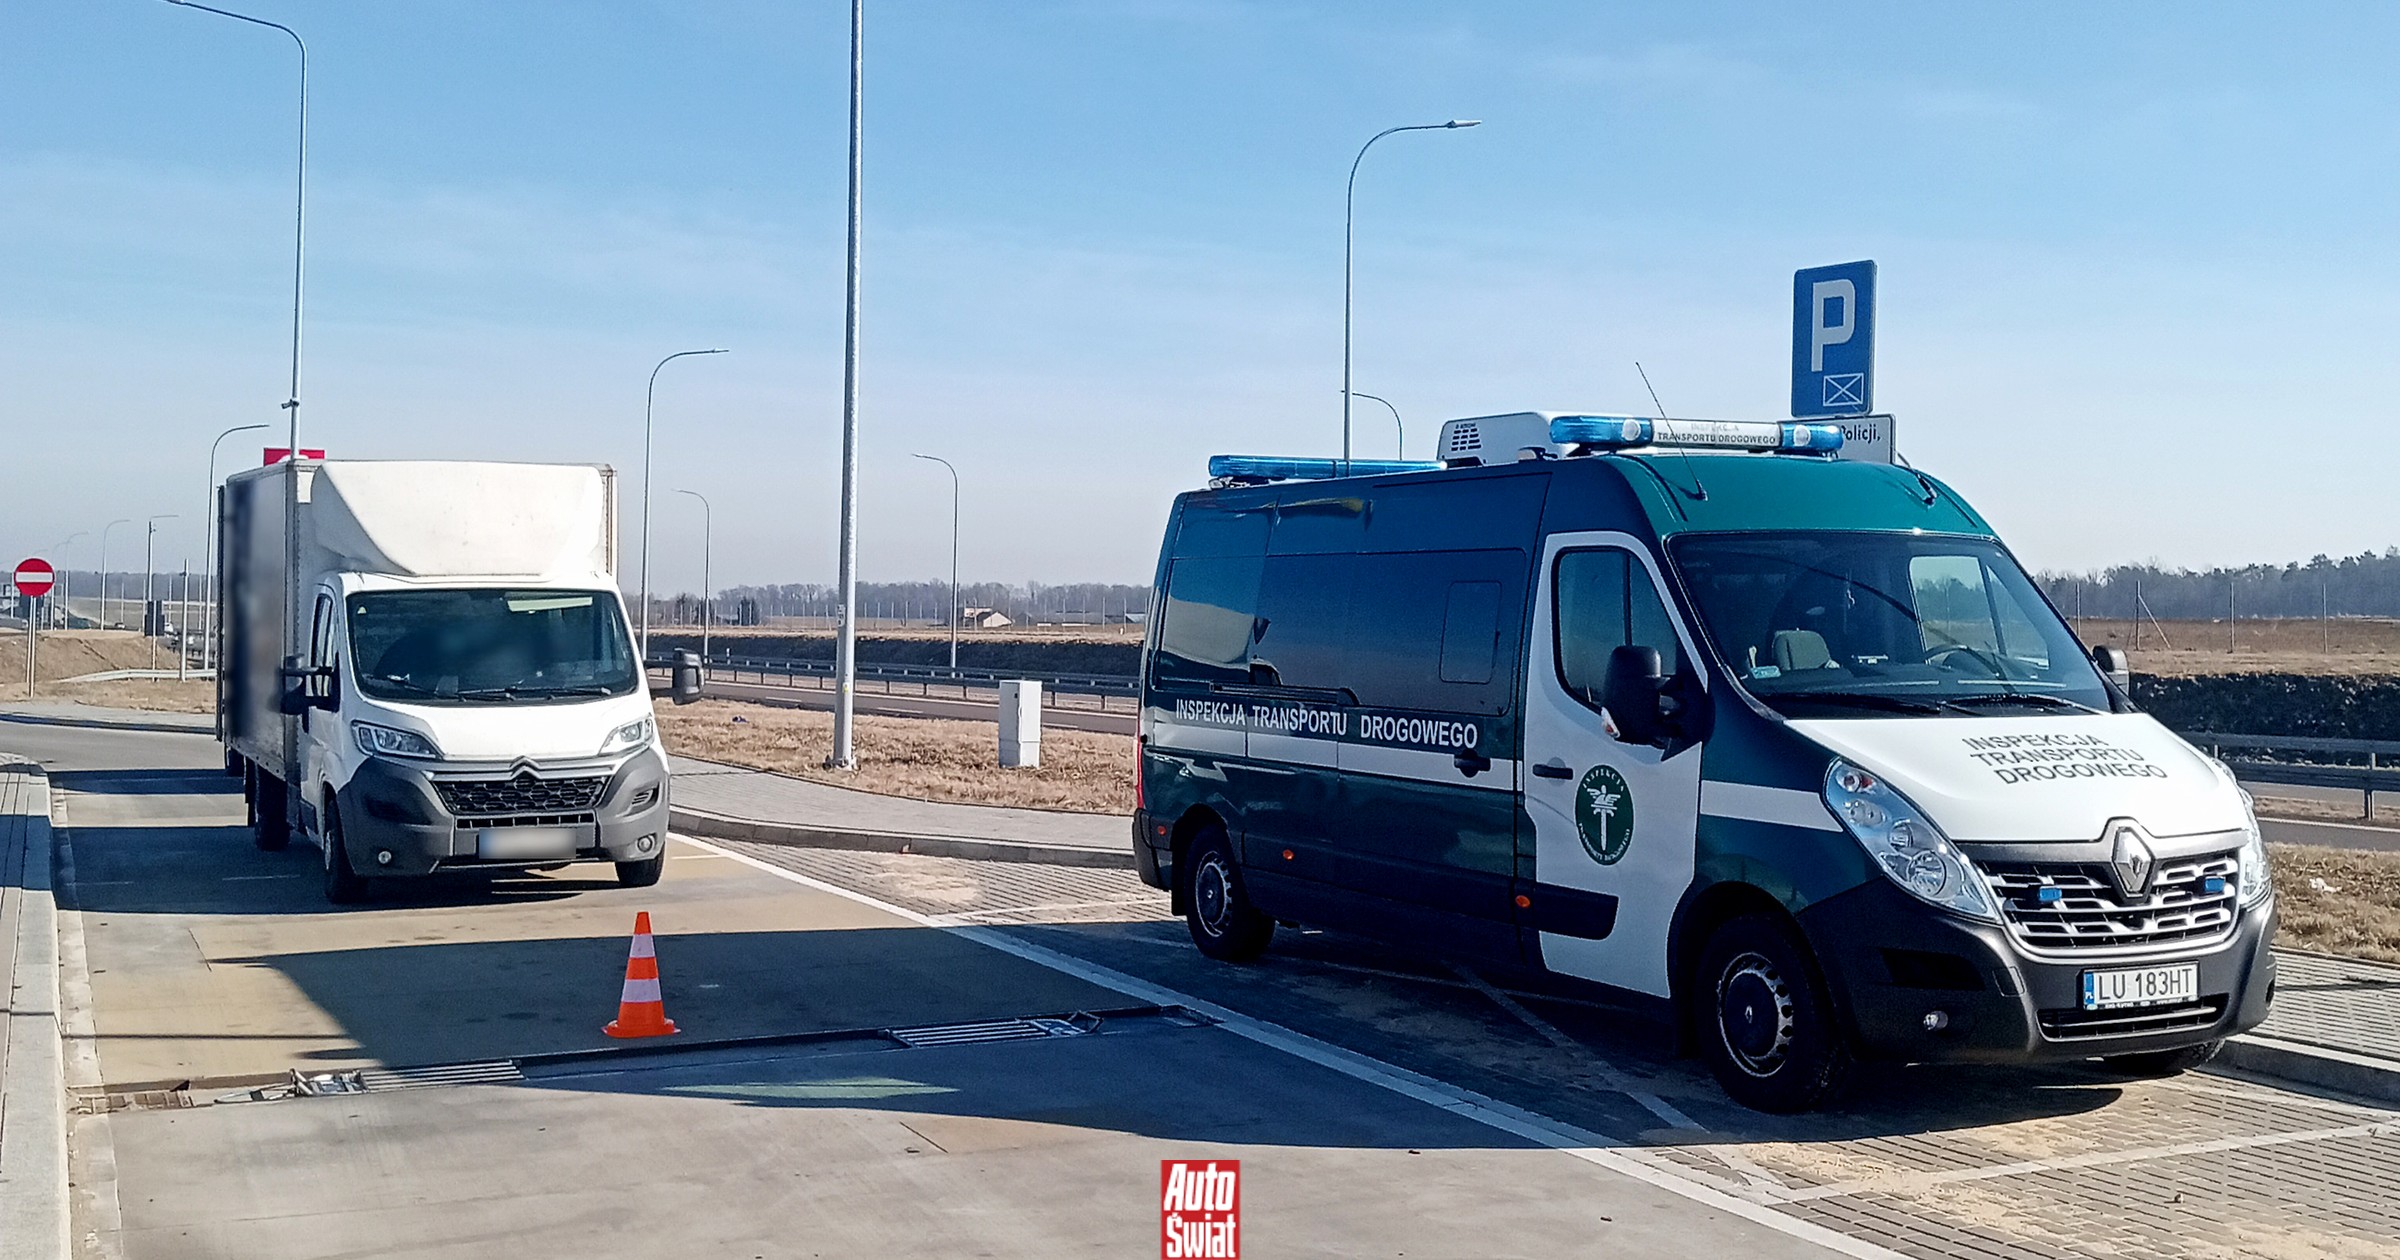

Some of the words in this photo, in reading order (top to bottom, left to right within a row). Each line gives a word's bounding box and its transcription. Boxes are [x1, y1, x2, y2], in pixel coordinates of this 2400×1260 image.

[1811, 279, 1855, 372] P
[1657, 431, 1716, 443] TRANSPORTU
[1718, 434, 1776, 445] DROGOWEGO
[1176, 698, 1246, 725] INSPEKCJA
[1252, 705, 1347, 736] TRANSPORTU
[1360, 715, 1478, 749] DROGOWEGO
[1961, 734, 2109, 751] INSPEKCJA
[1969, 748, 2144, 767] TRANSPORTU
[1993, 763, 2168, 785] DROGOWEGO
[2099, 974, 2126, 1000] LU
[2135, 968, 2193, 998] 183HT
